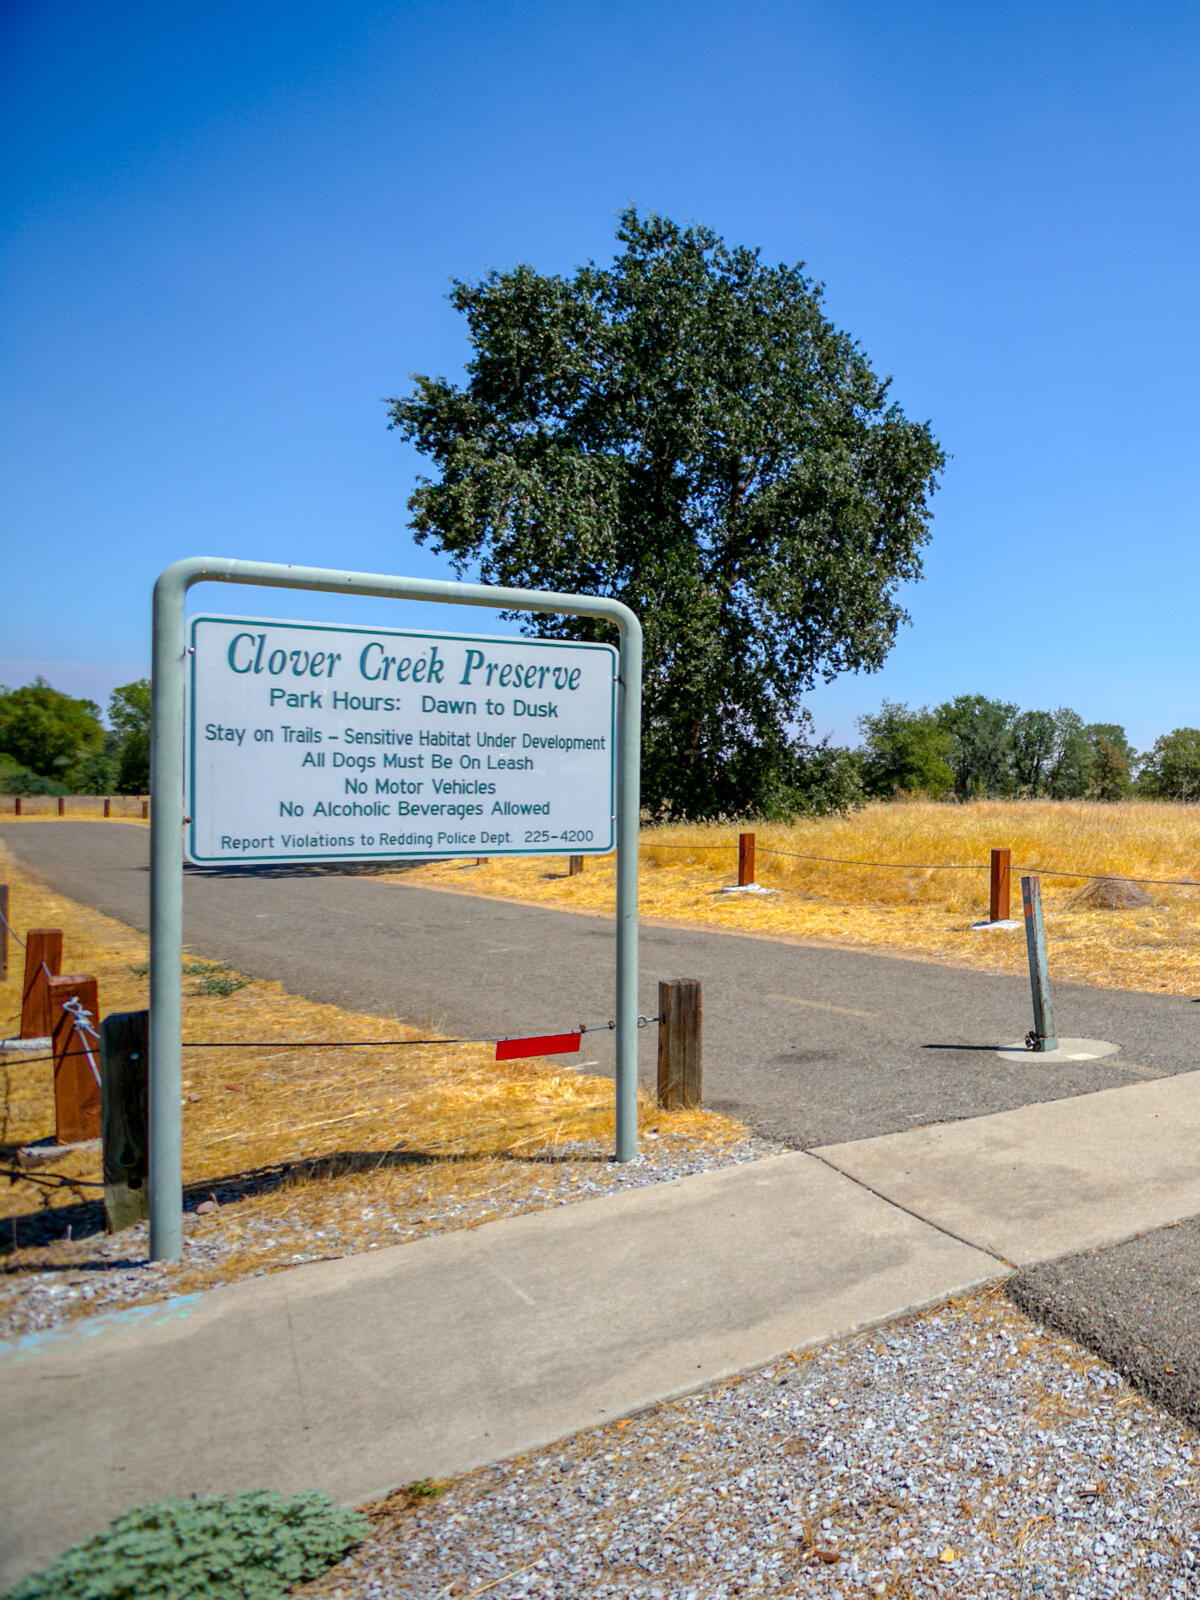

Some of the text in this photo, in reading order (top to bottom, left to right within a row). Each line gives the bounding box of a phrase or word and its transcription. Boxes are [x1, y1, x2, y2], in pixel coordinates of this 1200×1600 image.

[227, 632, 581, 691] Clover Creek Preserve
[270, 688, 558, 719] Park Hours: Dawn to Dusk
[205, 724, 246, 746] Stay
[254, 728, 274, 742] on
[281, 726, 322, 743] Trails
[344, 728, 413, 746] Sensitive
[419, 730, 471, 747] Habitat
[477, 732, 517, 748] Under
[522, 734, 606, 752] Development
[302, 752, 534, 772] All Dogs Must Be On Leash
[344, 779, 496, 795] No Motor Vehicles
[279, 800, 550, 821] No Alcoholic Beverages Allowed
[221, 829, 594, 852] Report Violations to Redding Police Dept. 225-4200
